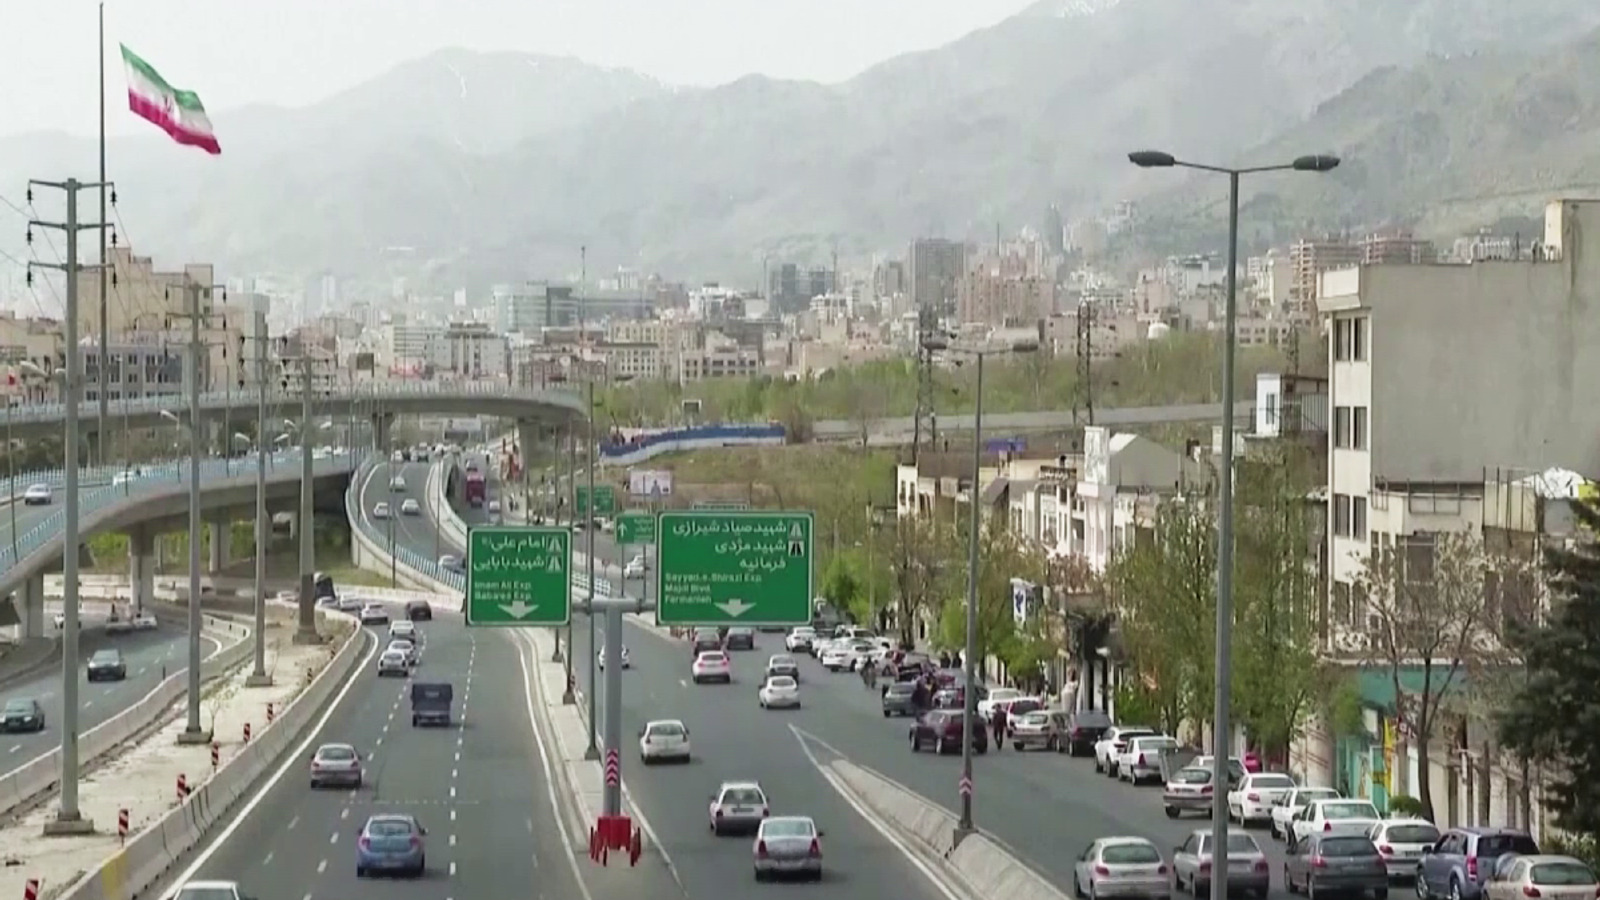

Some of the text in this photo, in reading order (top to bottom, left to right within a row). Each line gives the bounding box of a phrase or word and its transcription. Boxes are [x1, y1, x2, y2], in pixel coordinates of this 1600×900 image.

[672, 519, 720, 537] شیرازی
[721, 520, 753, 537] صیاد
[753, 519, 787, 536] شهید
[514, 535, 545, 553] امام
[714, 537, 787, 556] شهید مژدی
[473, 554, 545, 573] شهید بابایی
[739, 556, 787, 573] فرمانیه
